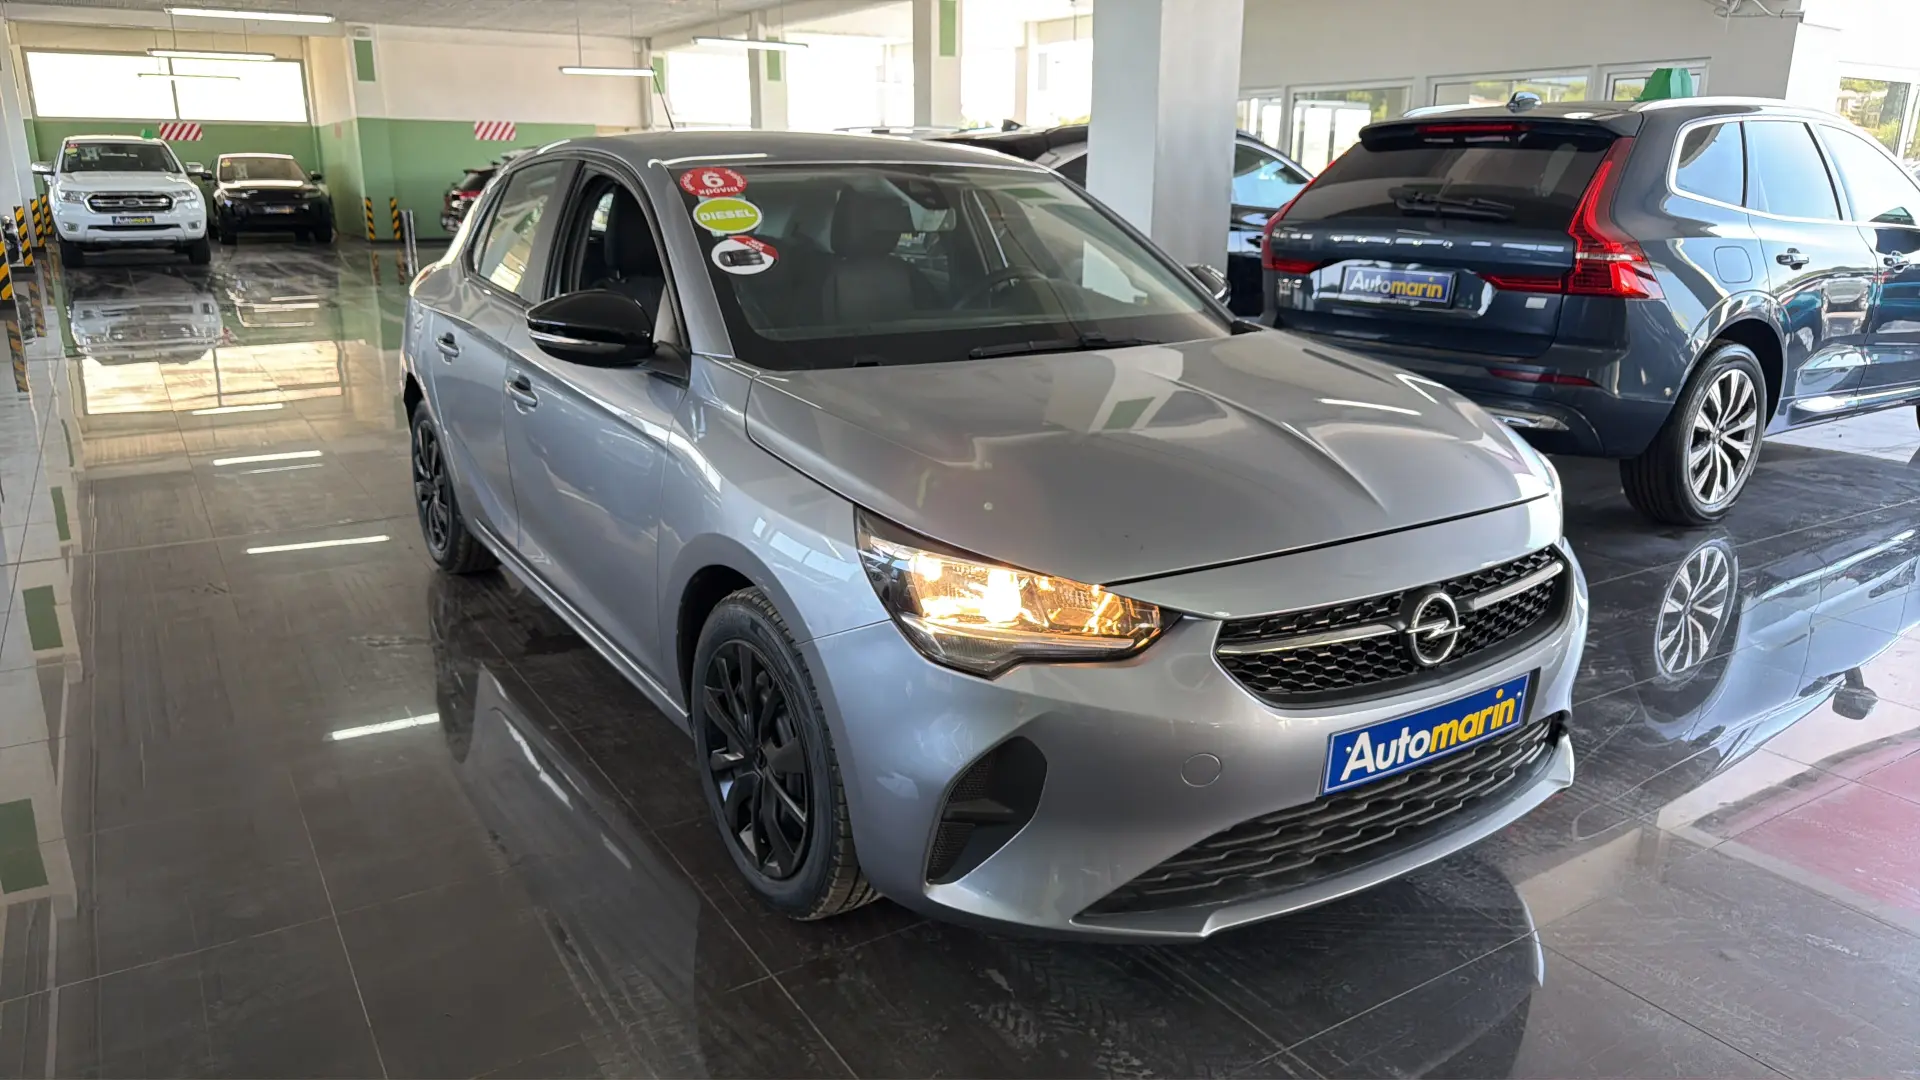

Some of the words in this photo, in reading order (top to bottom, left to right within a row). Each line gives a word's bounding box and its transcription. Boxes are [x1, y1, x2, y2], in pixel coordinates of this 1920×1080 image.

[702, 171, 724, 188] 6
[699, 209, 755, 222] DIESEL
[1349, 271, 1443, 298] Automarin
[1340, 689, 1515, 781] Automarin
